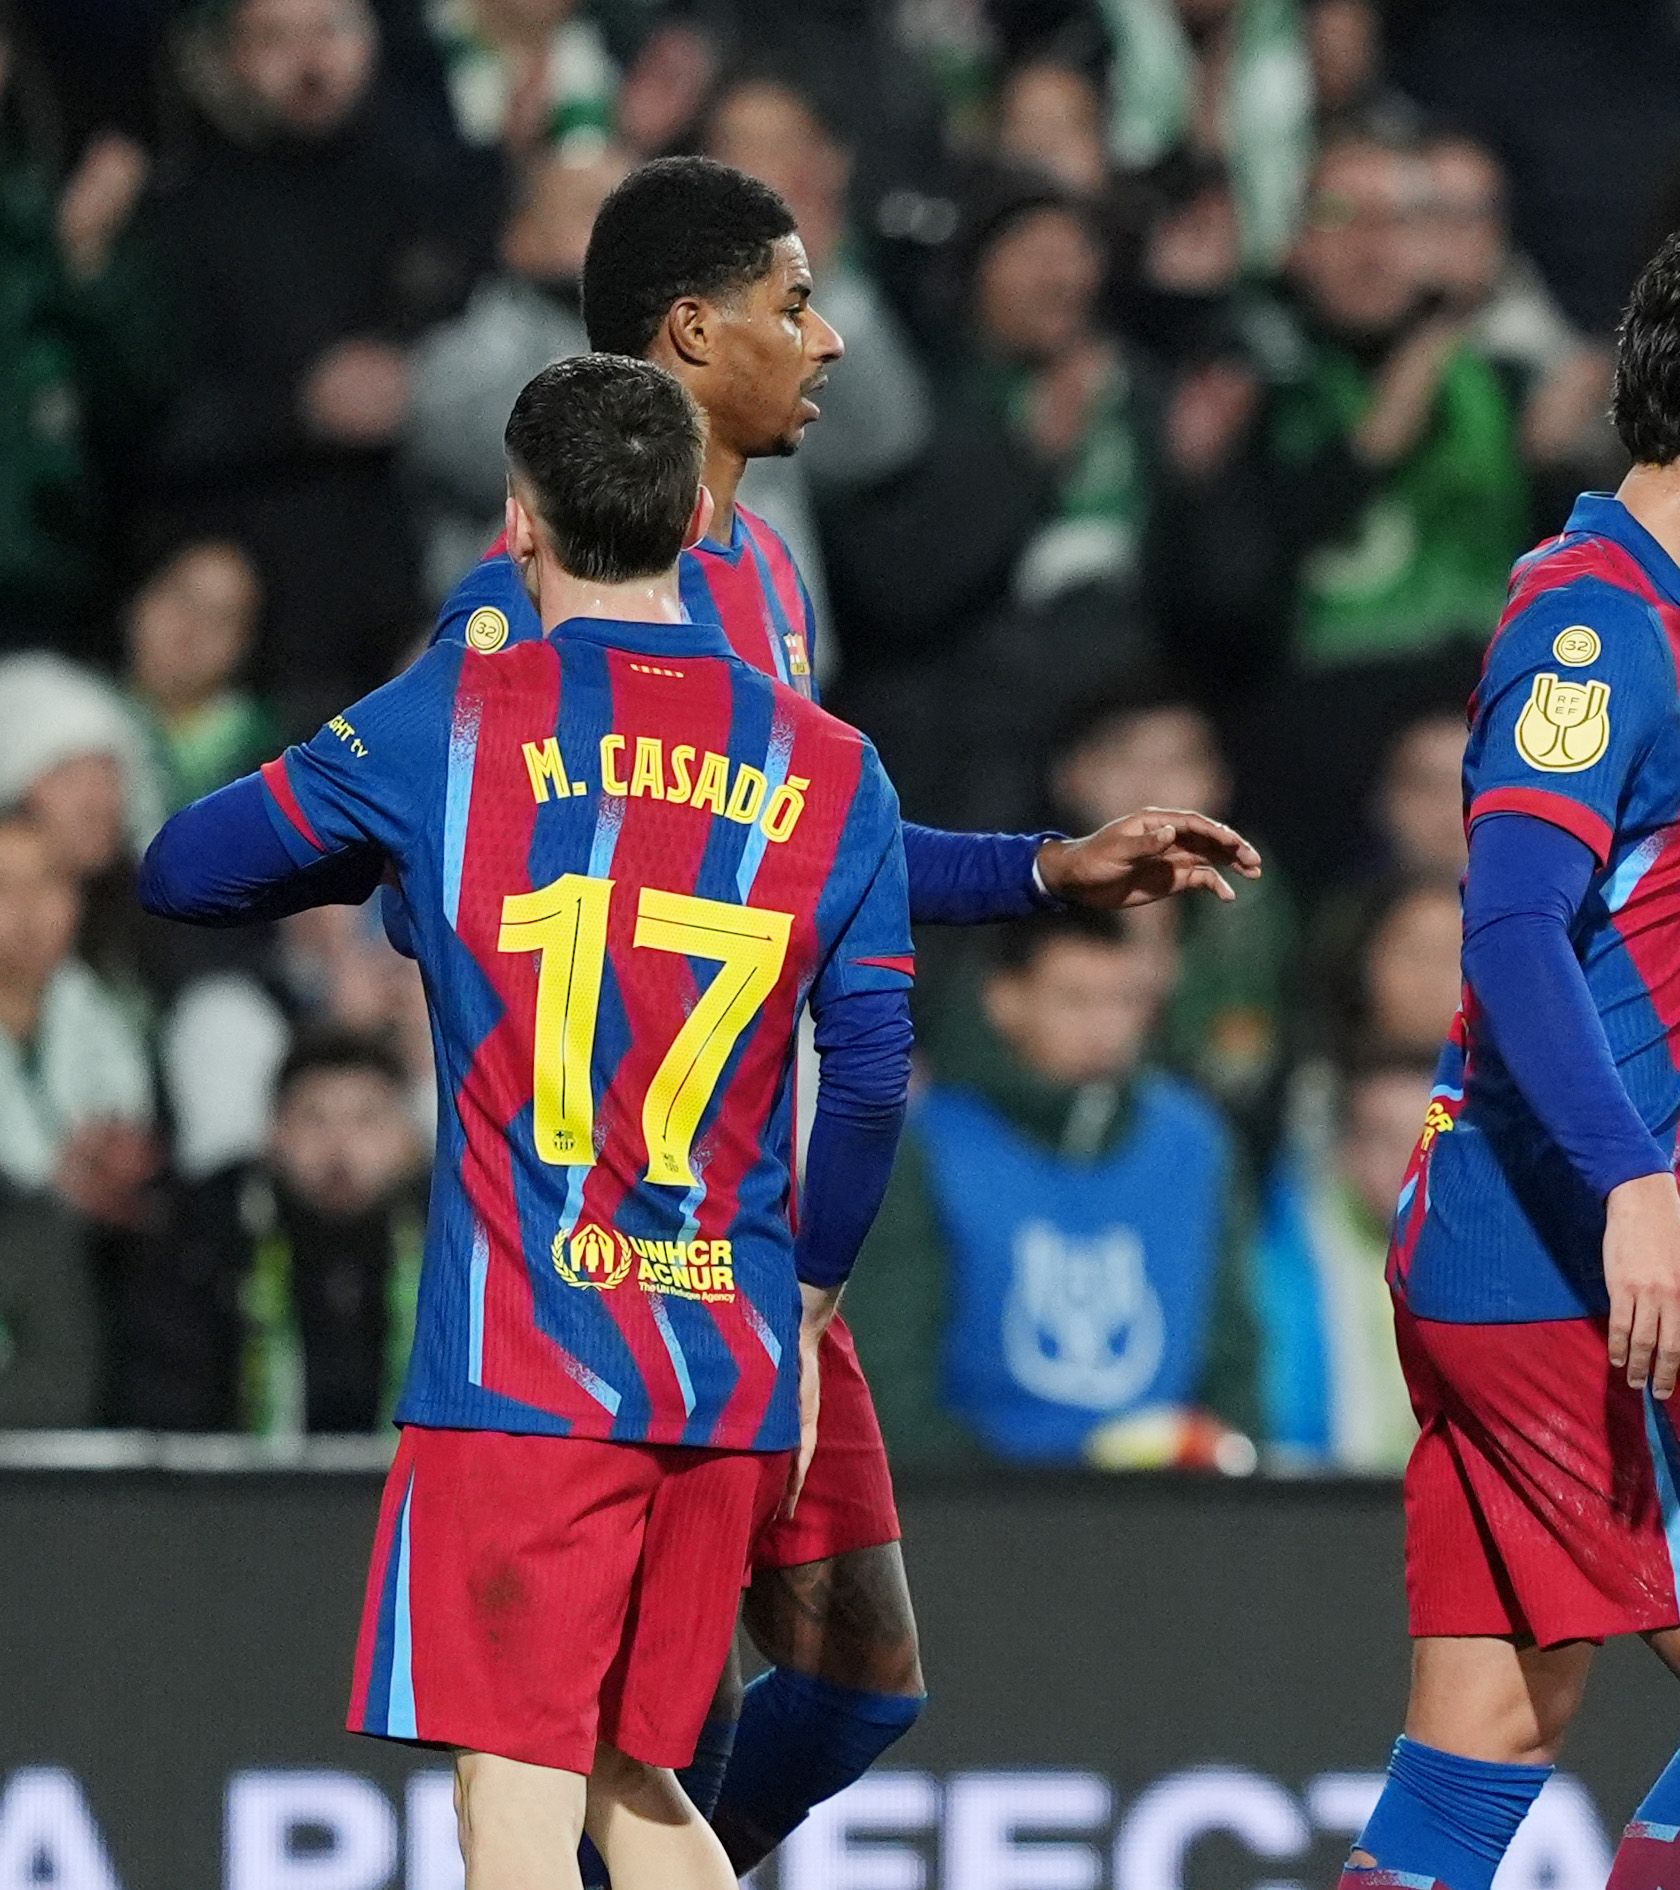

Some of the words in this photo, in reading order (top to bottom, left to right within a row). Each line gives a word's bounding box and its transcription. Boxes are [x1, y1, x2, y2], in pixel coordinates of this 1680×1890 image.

[475, 621, 498, 640] 32
[1564, 640, 1589, 653] 32
[350, 738, 369, 758] tv
[520, 736, 588, 804] M.
[599, 733, 812, 844] CASADÓ
[497, 872, 796, 1188] 17
[628, 1235, 733, 1266] UNHCR
[637, 1258, 736, 1291] ACNUR
[638, 1281, 656, 1293] The
[701, 1291, 736, 1304] Agency
